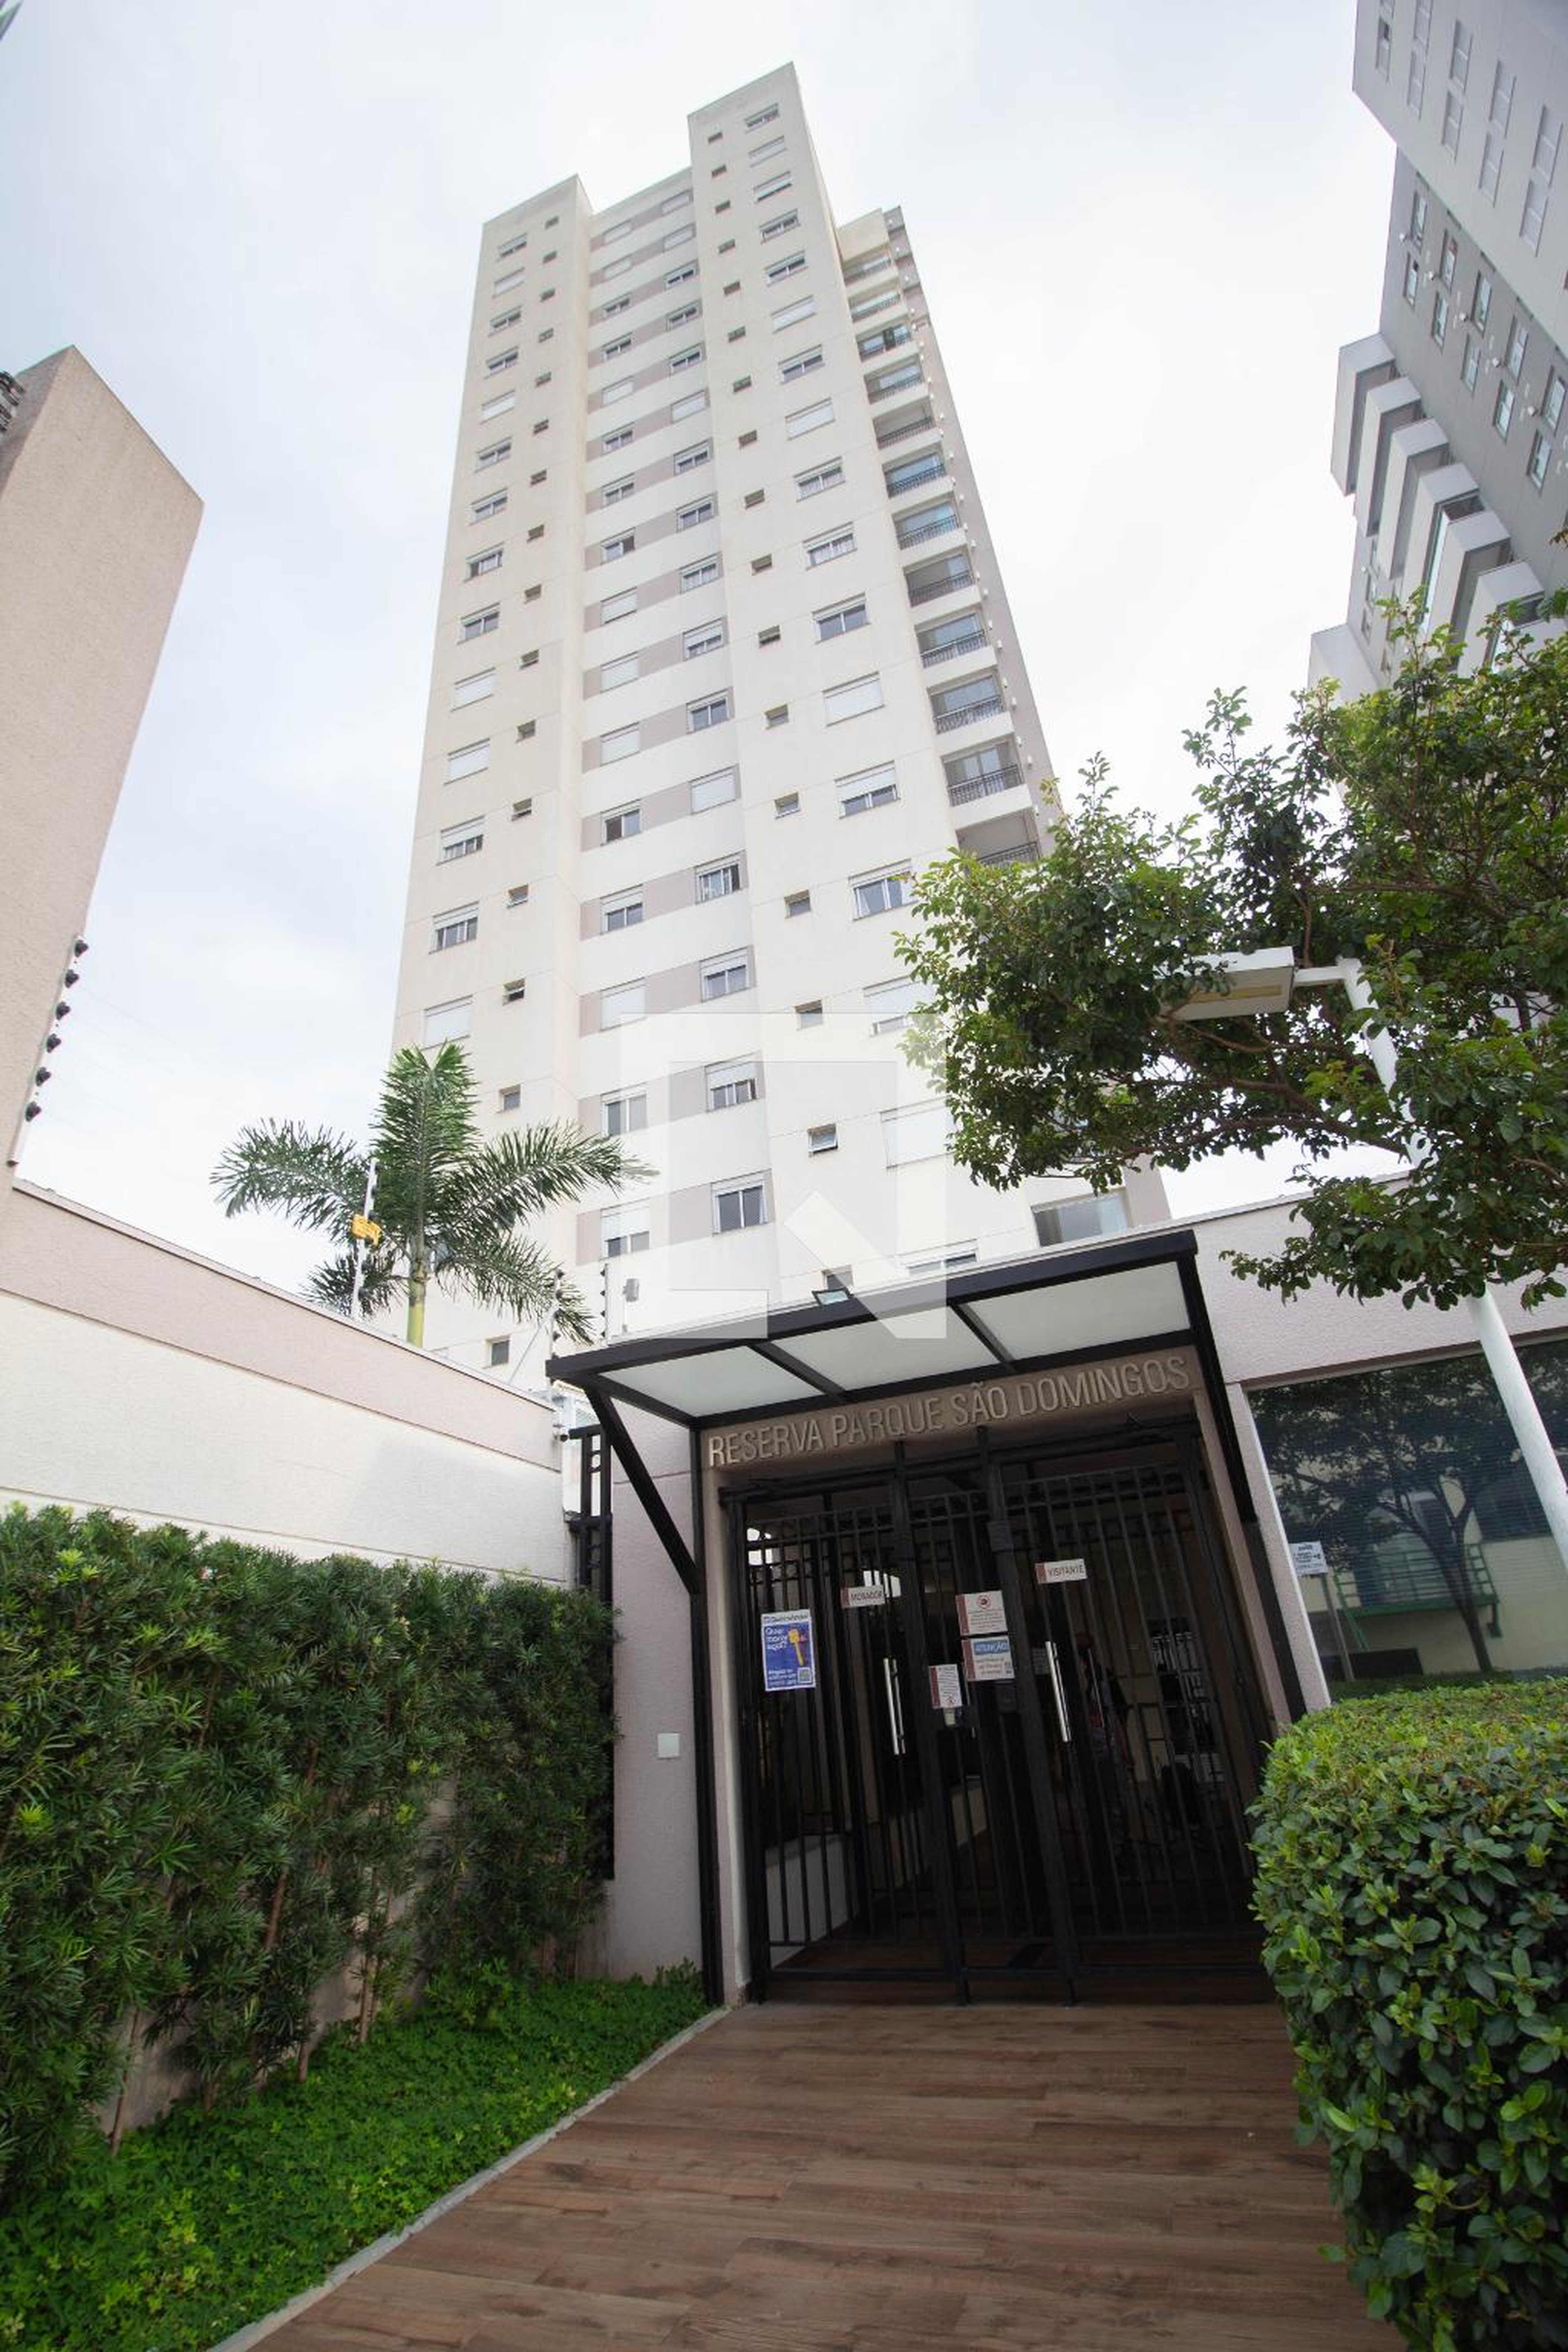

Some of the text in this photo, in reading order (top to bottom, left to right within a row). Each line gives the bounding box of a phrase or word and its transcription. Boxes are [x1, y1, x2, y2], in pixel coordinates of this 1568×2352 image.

[708, 1356, 1189, 1468] RESERVA PARQUE SÃO DOMINGOS
[1047, 1565, 1085, 1577] VISITANTE
[851, 1590, 882, 1600] MORADOR
